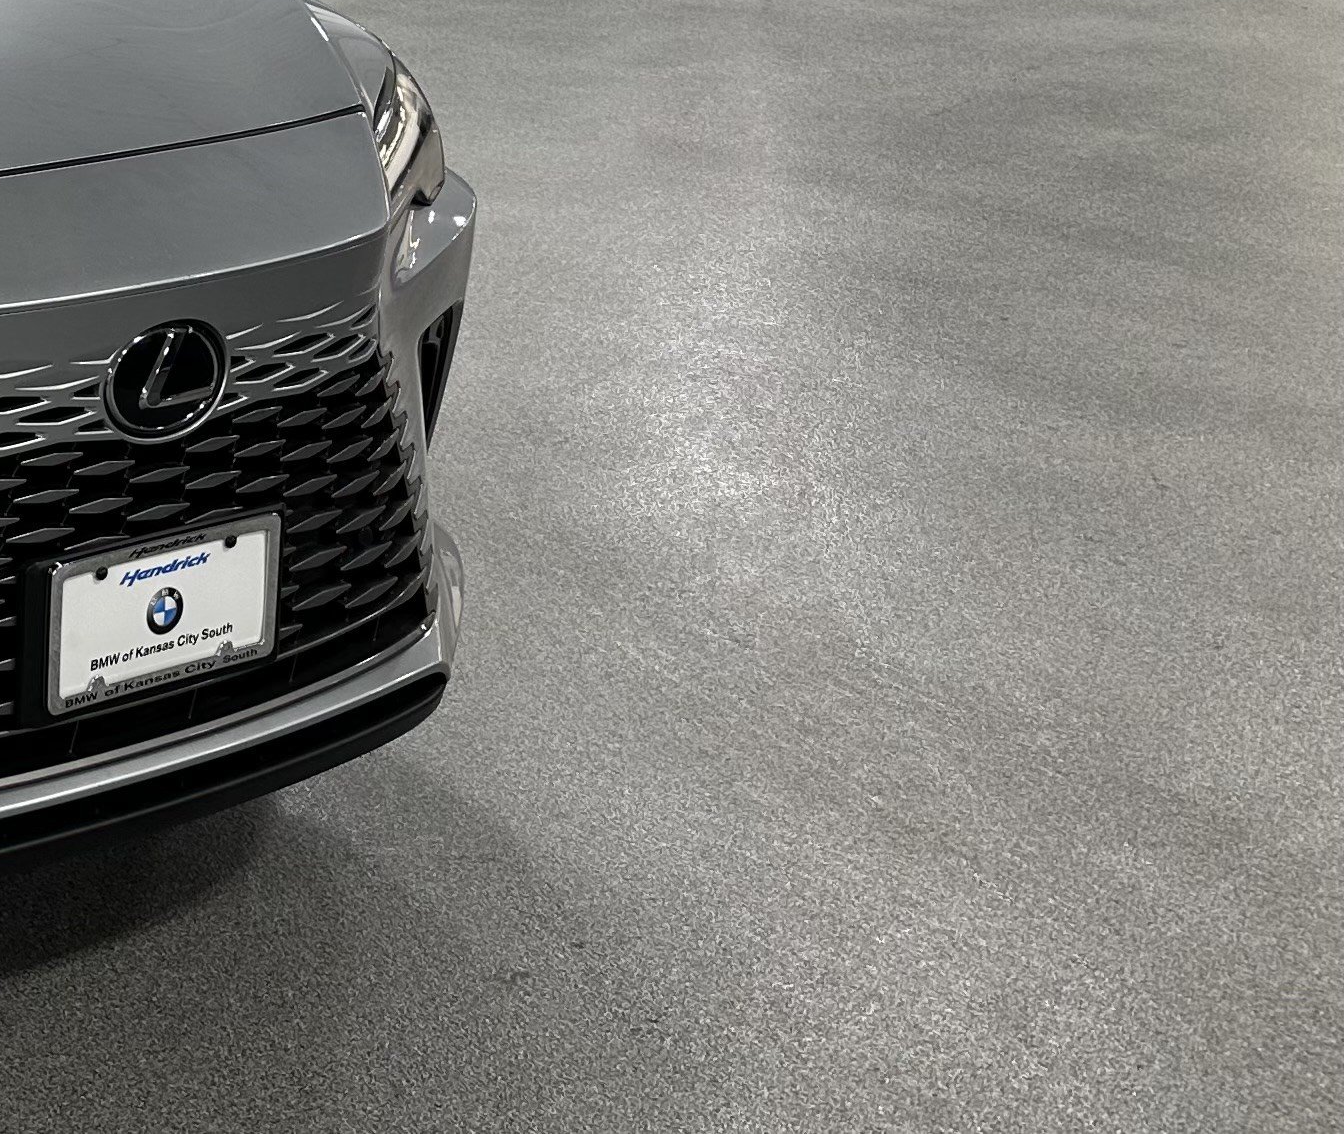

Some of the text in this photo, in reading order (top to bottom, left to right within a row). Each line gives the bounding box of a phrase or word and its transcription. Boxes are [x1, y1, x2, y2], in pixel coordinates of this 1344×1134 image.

[129, 533, 207, 559] Hendrick
[119, 551, 211, 587] Hendrick
[90, 622, 234, 672] BMW of Kansas City South
[65, 647, 258, 709] BMW of Kansas City South
